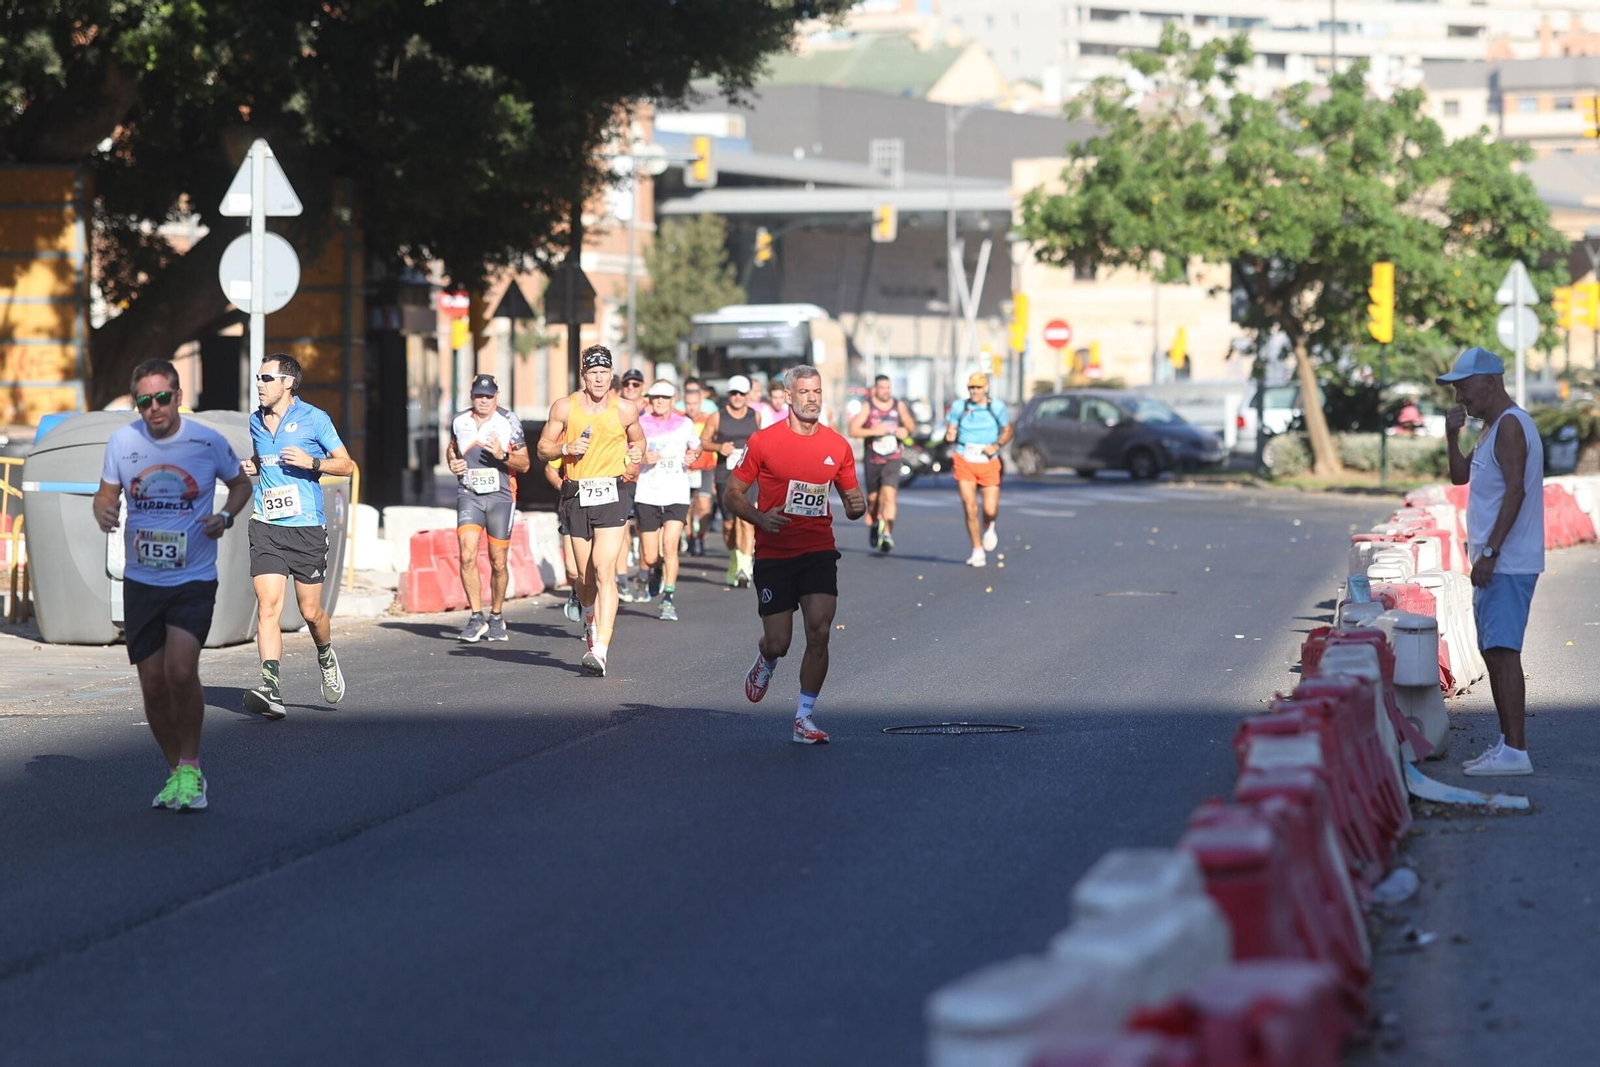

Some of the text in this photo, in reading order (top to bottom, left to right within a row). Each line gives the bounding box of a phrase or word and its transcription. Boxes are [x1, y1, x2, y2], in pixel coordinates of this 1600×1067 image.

[472, 476, 495, 485] 258
[265, 496, 294, 510] 336
[792, 492, 825, 506] 208
[141, 543, 177, 558] 153
